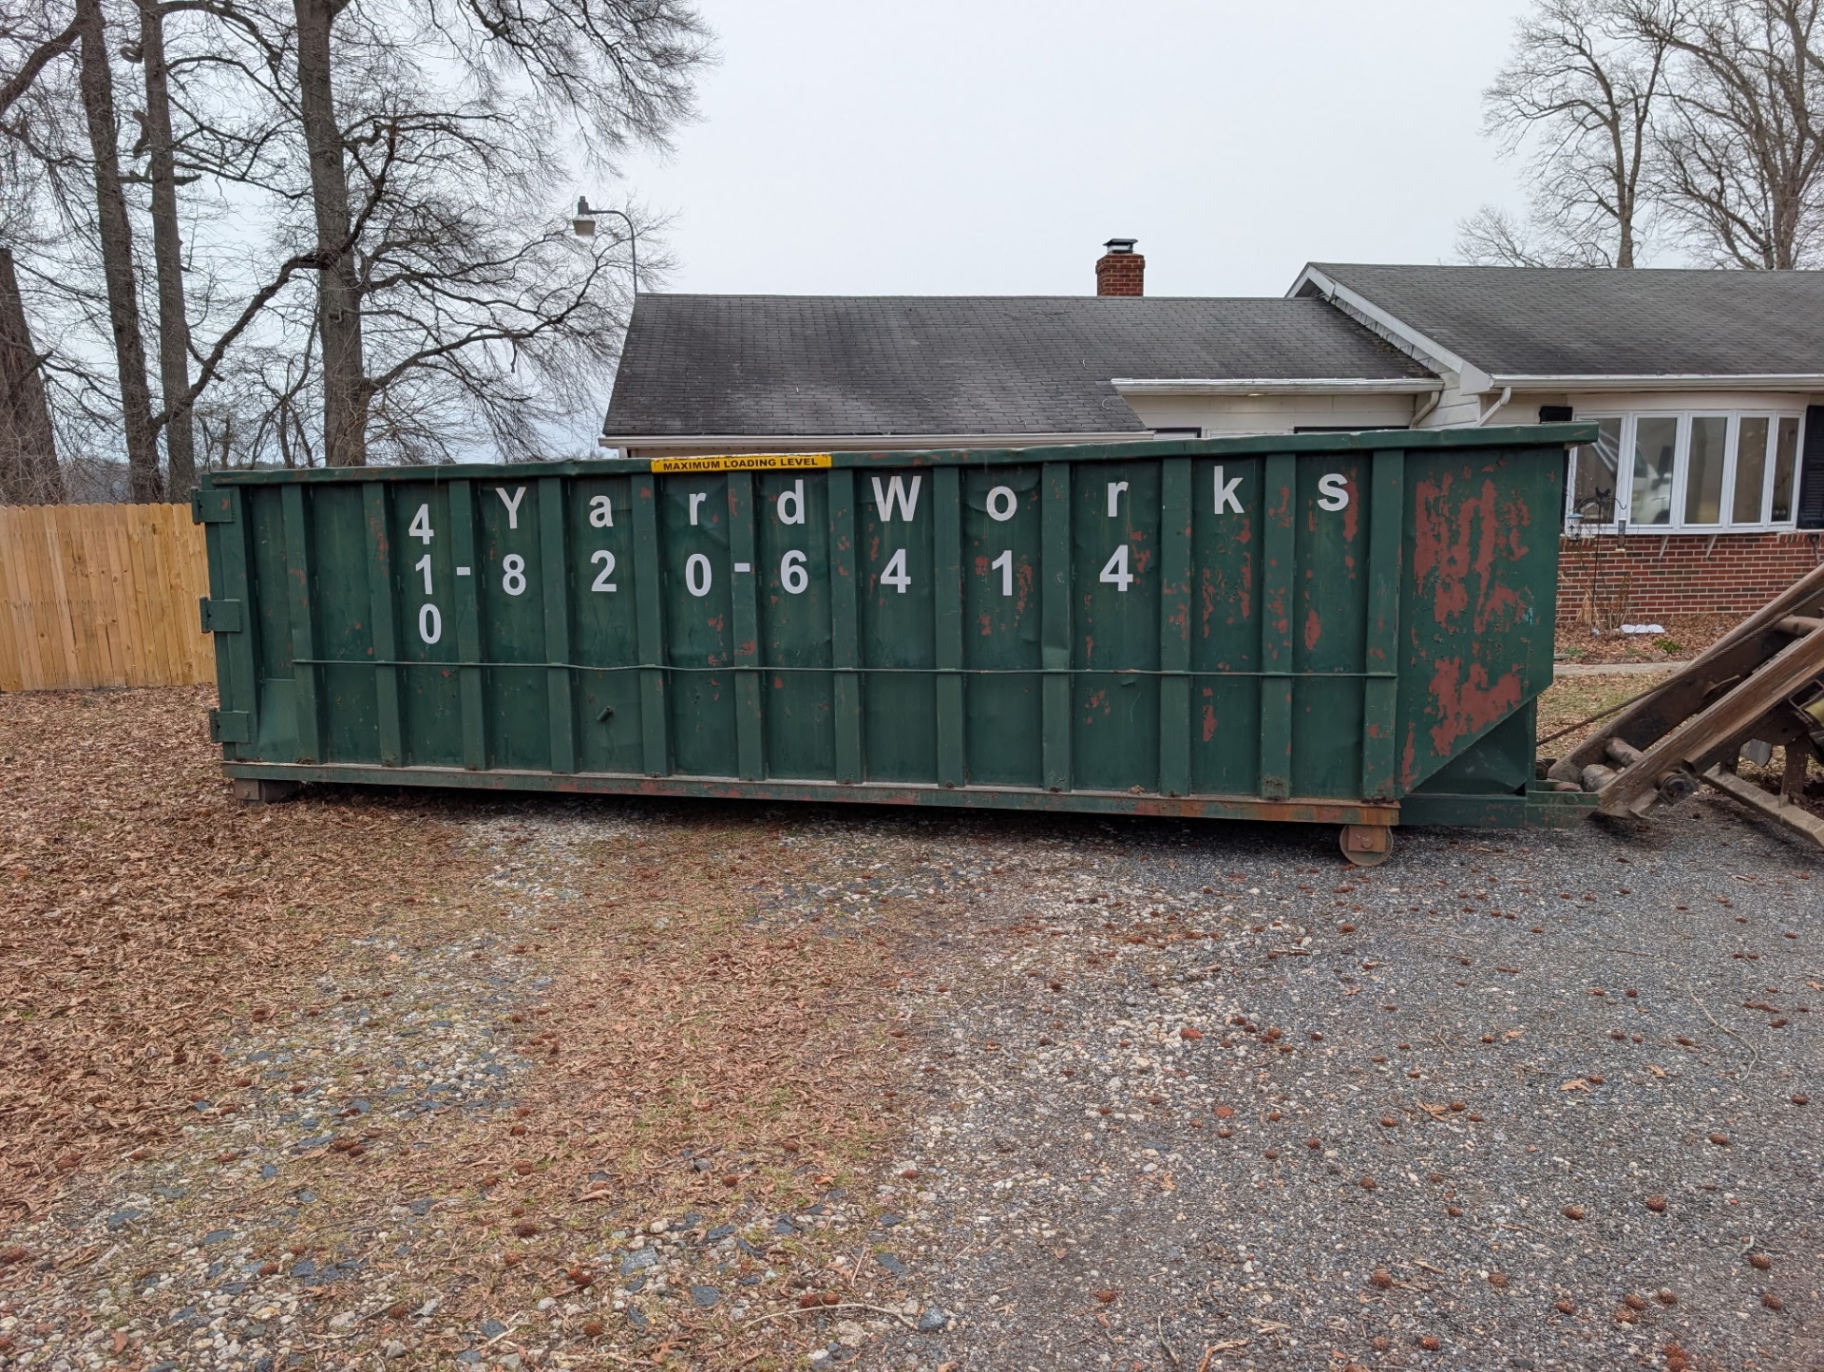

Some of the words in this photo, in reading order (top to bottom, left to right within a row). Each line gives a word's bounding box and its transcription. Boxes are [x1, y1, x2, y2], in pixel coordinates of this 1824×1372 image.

[663, 460, 721, 471] MAXIMUM
[724, 458, 777, 469] LOADING
[780, 457, 818, 467] LEVEL
